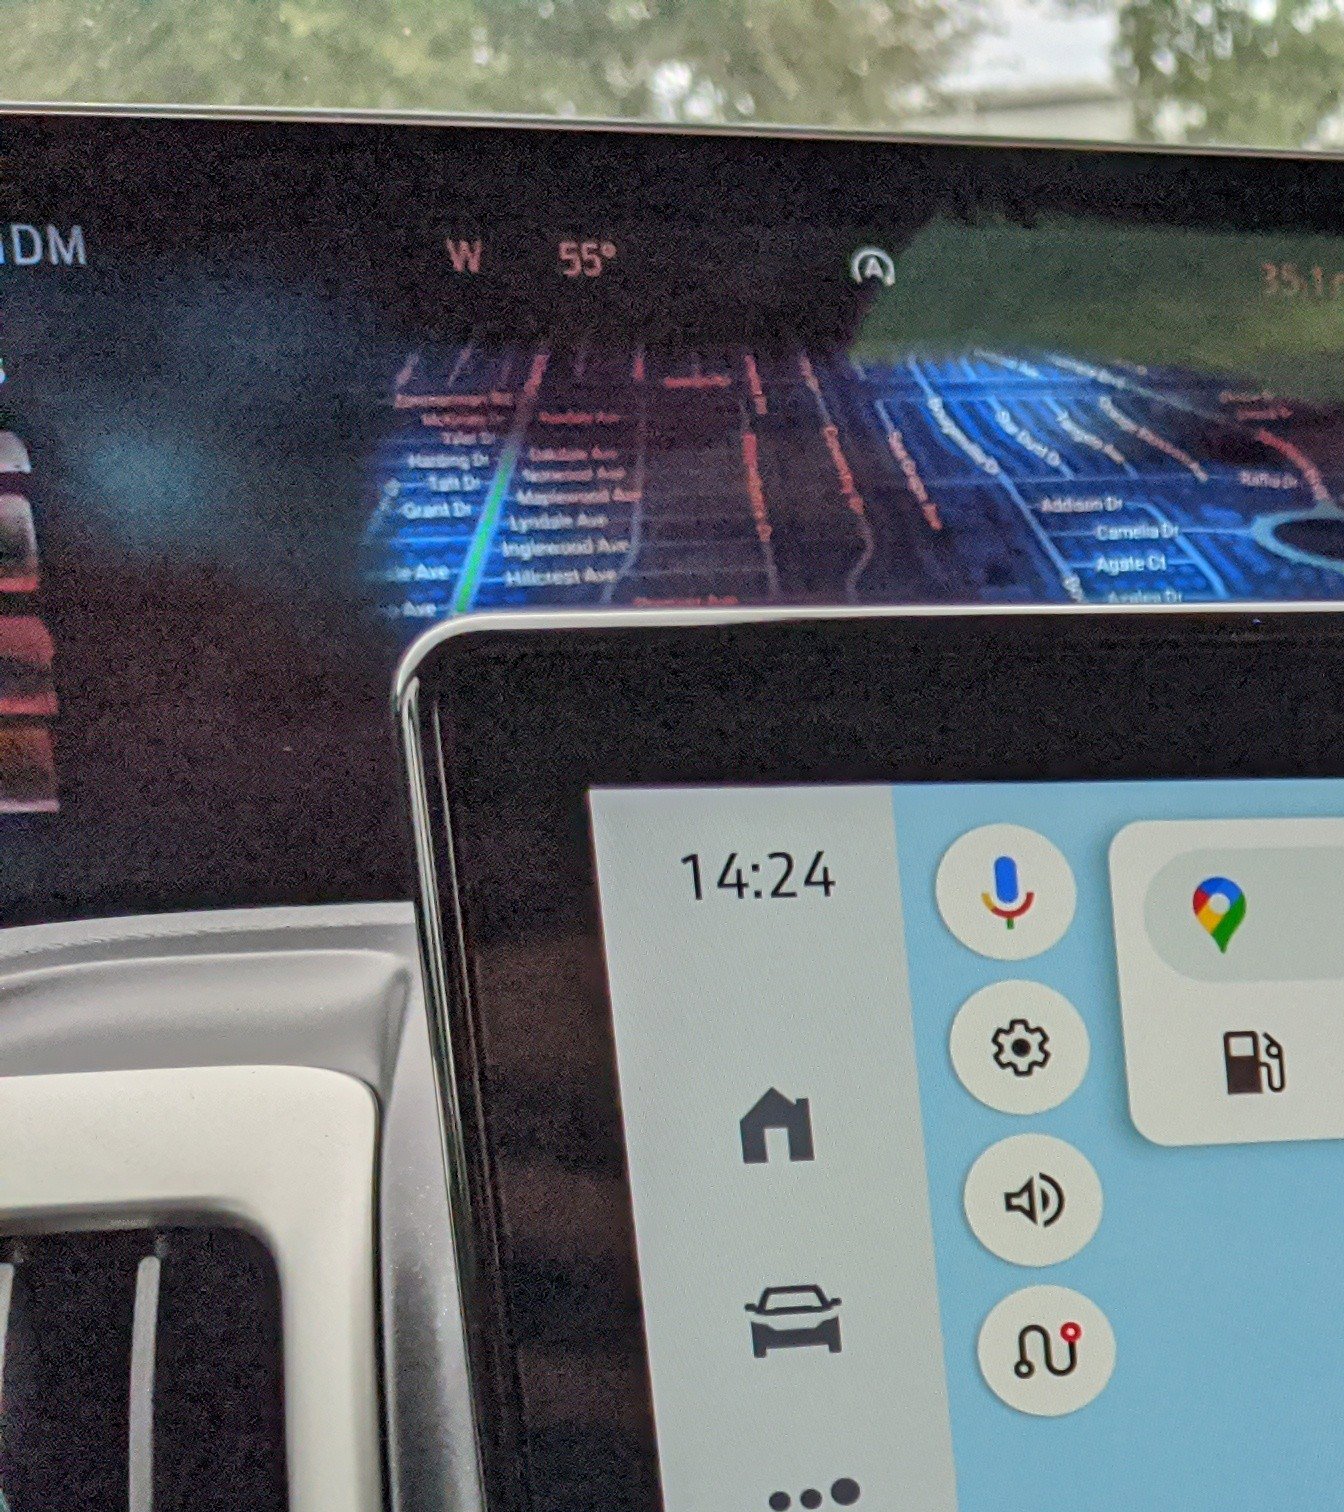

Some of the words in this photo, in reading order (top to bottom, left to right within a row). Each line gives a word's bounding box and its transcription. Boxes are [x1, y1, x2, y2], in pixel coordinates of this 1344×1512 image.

[445, 238, 482, 274] W
[558, 239, 617, 277] 55°
[472, 453, 490, 468] Dr
[463, 475, 481, 492] Dr
[403, 500, 451, 519] Grant
[453, 498, 472, 516] Dr
[1105, 496, 1124, 512] Dr
[576, 514, 610, 528] Ave
[1159, 521, 1180, 538] Dr
[502, 538, 593, 561] Inglewood
[596, 537, 632, 553] Ave
[414, 564, 450, 581] Ave
[1096, 554, 1145, 575] Agate
[1148, 552, 1168, 572] Ct
[504, 568, 580, 588] Hillcrest
[581, 566, 619, 583] Ave
[402, 601, 437, 617] Ave
[681, 850, 837, 901] 14:24
